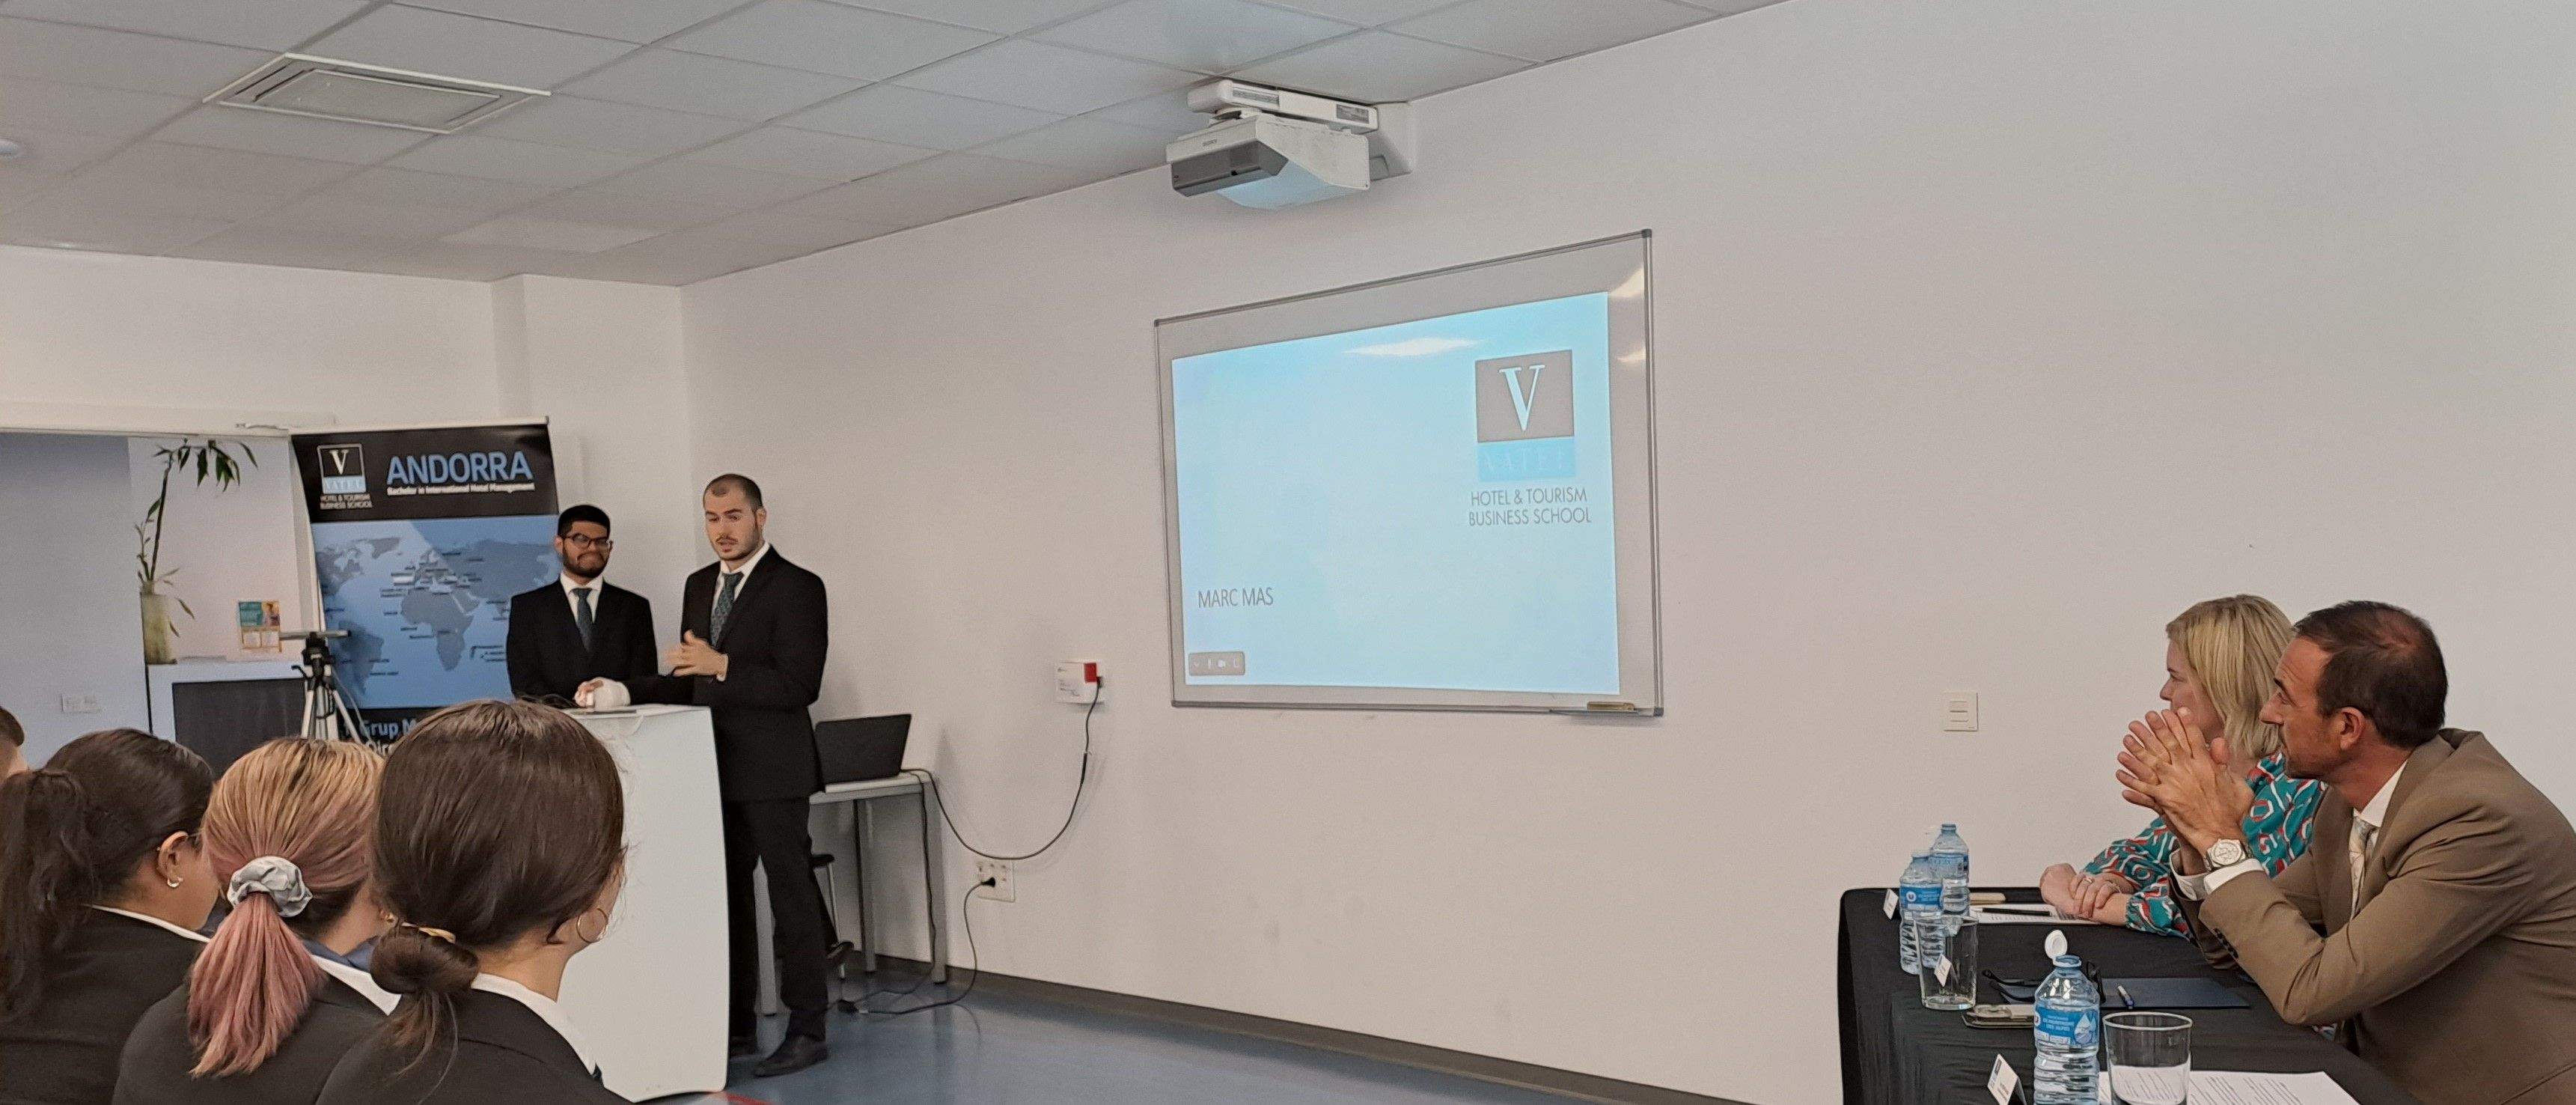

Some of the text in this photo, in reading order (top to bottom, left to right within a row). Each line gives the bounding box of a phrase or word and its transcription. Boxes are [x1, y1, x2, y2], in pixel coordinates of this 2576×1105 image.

[1498, 364, 1546, 432] V
[329, 449, 349, 475] V
[386, 450, 534, 485] ANDORRA
[489, 482, 535, 493] Management
[1471, 487, 1587, 506] HOTEL & TOURISM
[1468, 507, 1592, 526] BUSINESS SCHOOL
[1198, 586, 1274, 608] MARC MAS
[402, 718, 418, 734] M
